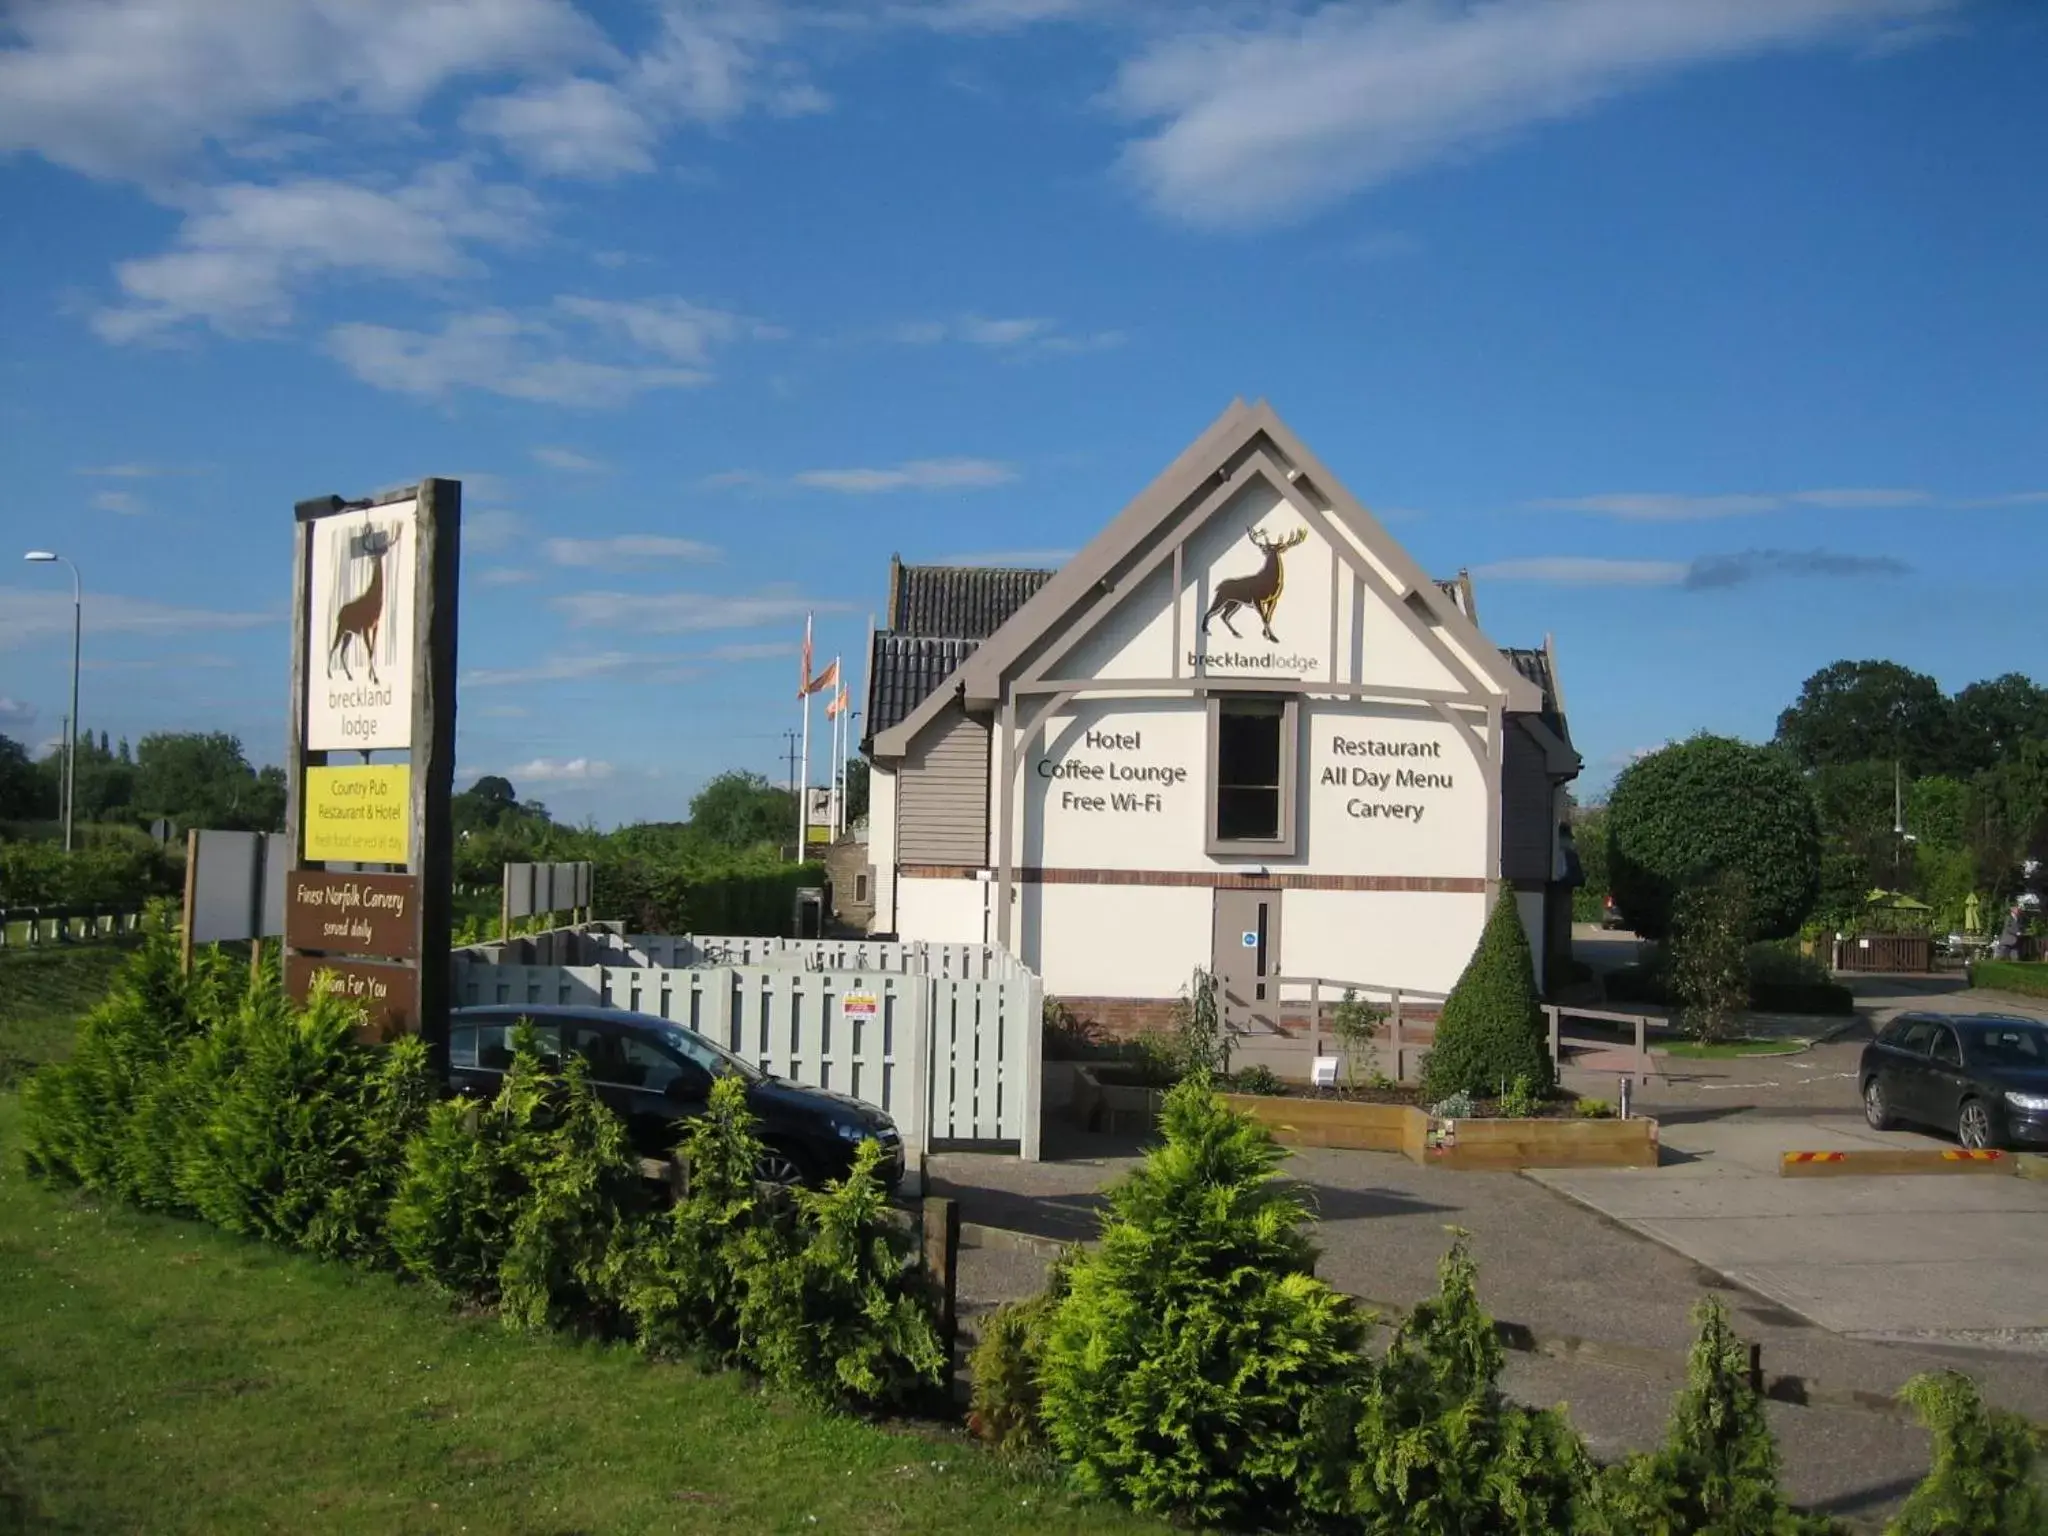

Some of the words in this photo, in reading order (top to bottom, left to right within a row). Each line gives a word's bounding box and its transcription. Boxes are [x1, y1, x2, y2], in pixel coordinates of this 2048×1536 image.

[328, 684, 392, 709] breckland
[341, 714, 377, 741] lodge
[1086, 730, 1141, 750] Hotel
[1332, 736, 1441, 757] Restaurant
[1038, 759, 1104, 779] Coffee
[1110, 762, 1187, 786] Lounge
[1321, 767, 1347, 786] All
[1352, 768, 1391, 791] Day
[1396, 769, 1453, 788] Menu
[331, 780, 366, 799] Country
[369, 779, 387, 795] Pub
[318, 804, 365, 819] Restaurant
[367, 805, 373, 819] &
[375, 803, 400, 820] Hotel
[1062, 792, 1106, 811] Free
[1111, 793, 1162, 812] Wi-Fi
[1346, 799, 1425, 823] Carvery
[297, 884, 324, 905] Finest
[326, 883, 360, 913] Norfolk
[363, 886, 404, 917] Carvery
[324, 918, 349, 936] served
[351, 918, 372, 945] daily
[347, 974, 365, 995] For
[367, 976, 387, 1000] You
